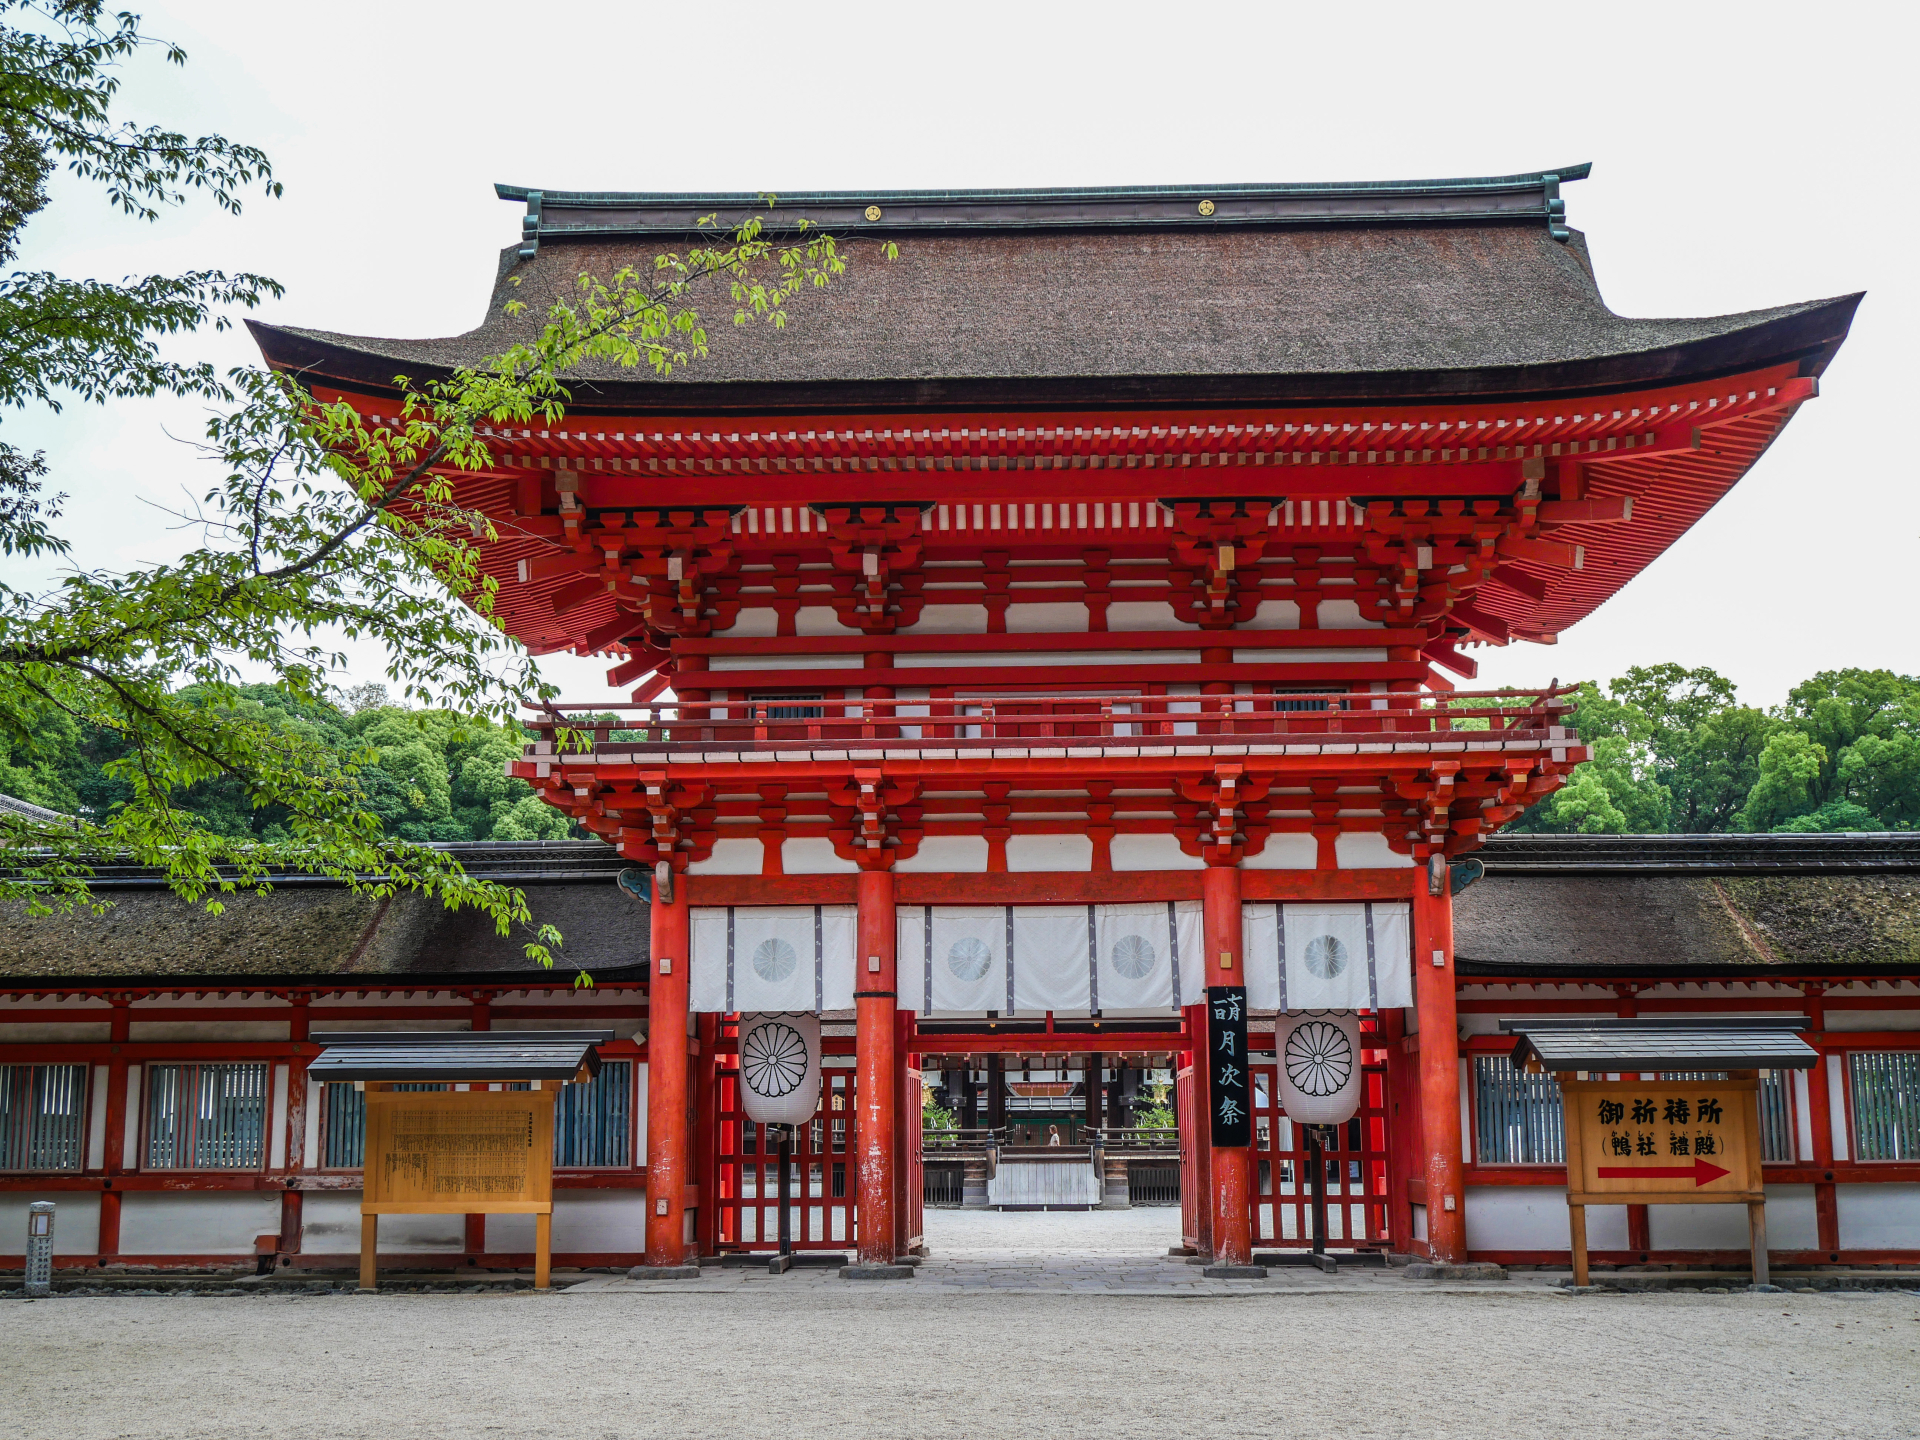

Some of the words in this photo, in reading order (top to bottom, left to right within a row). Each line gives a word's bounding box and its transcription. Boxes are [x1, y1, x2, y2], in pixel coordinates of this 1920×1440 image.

[1213, 1000, 1228, 1020] 一日
[1227, 994, 1243, 1021] 七月
[1218, 1030, 1246, 1126] 月次祭
[1597, 1098, 1723, 1125] 御祈祷所
